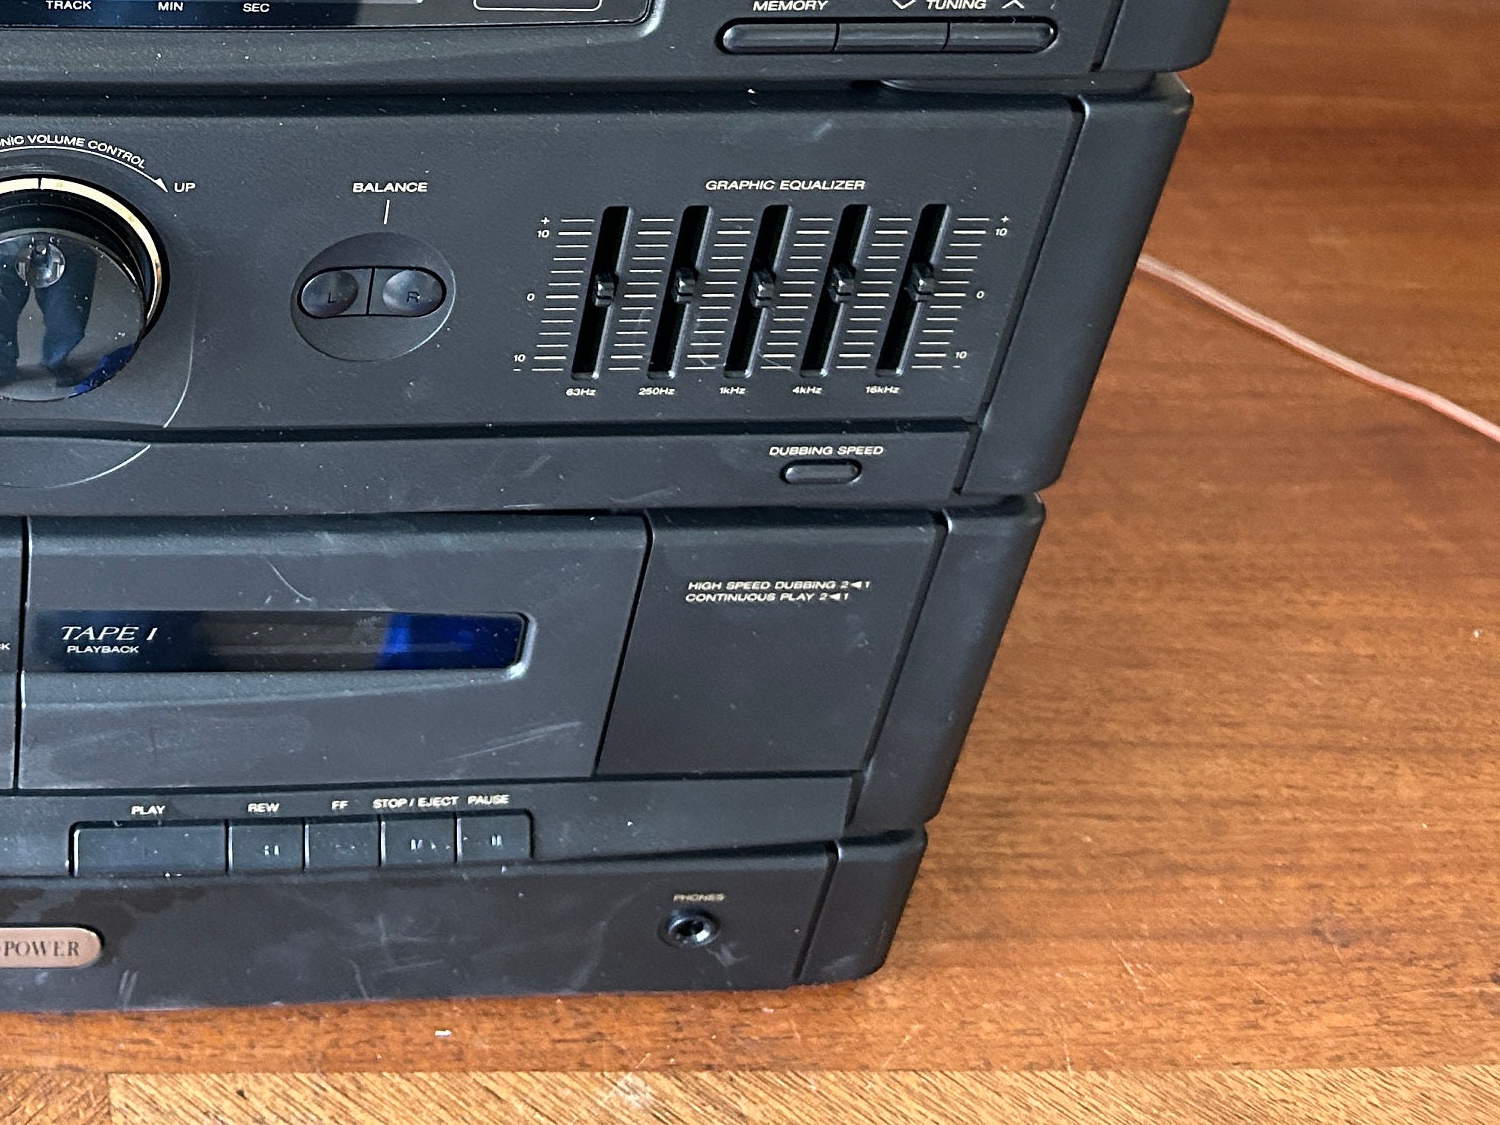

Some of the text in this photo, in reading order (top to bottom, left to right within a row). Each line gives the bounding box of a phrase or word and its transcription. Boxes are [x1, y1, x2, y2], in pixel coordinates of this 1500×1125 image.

[46, 0, 92, 12] TRACK
[158, 0, 184, 12] MIN
[243, 2, 270, 14] SEC
[752, 0, 828, 12] MEMORY
[926, 0, 988, 12] TUNING
[27, 134, 86, 147] VOLUME
[87, 139, 147, 170] CONTROL
[174, 182, 197, 193] UP
[352, 181, 429, 194] BALANCE
[705, 179, 866, 192] GRAPHIC EQUALIZER
[536, 229, 551, 239] 10
[994, 228, 1009, 237] 10
[513, 354, 527, 363] 10
[954, 350, 968, 359] 10
[566, 386, 597, 397] 63Hz
[638, 386, 676, 397] 250Hz
[718, 385, 747, 396] 1kHz
[792, 385, 823, 396] 4kHz
[865, 384, 901, 395] 16kHz
[768, 445, 884, 456] DUBBING SPEED
[687, 580, 836, 591] HIGH SPEED DUBBING
[685, 592, 815, 603] CONTINUOUS PLAY
[61, 625, 160, 641] TAPE 1
[66, 644, 140, 655] PLAYBACK
[467, 794, 510, 806] PAUSE
[130, 804, 166, 816] PLAY
[247, 802, 280, 814] REW
[331, 800, 349, 812] FF
